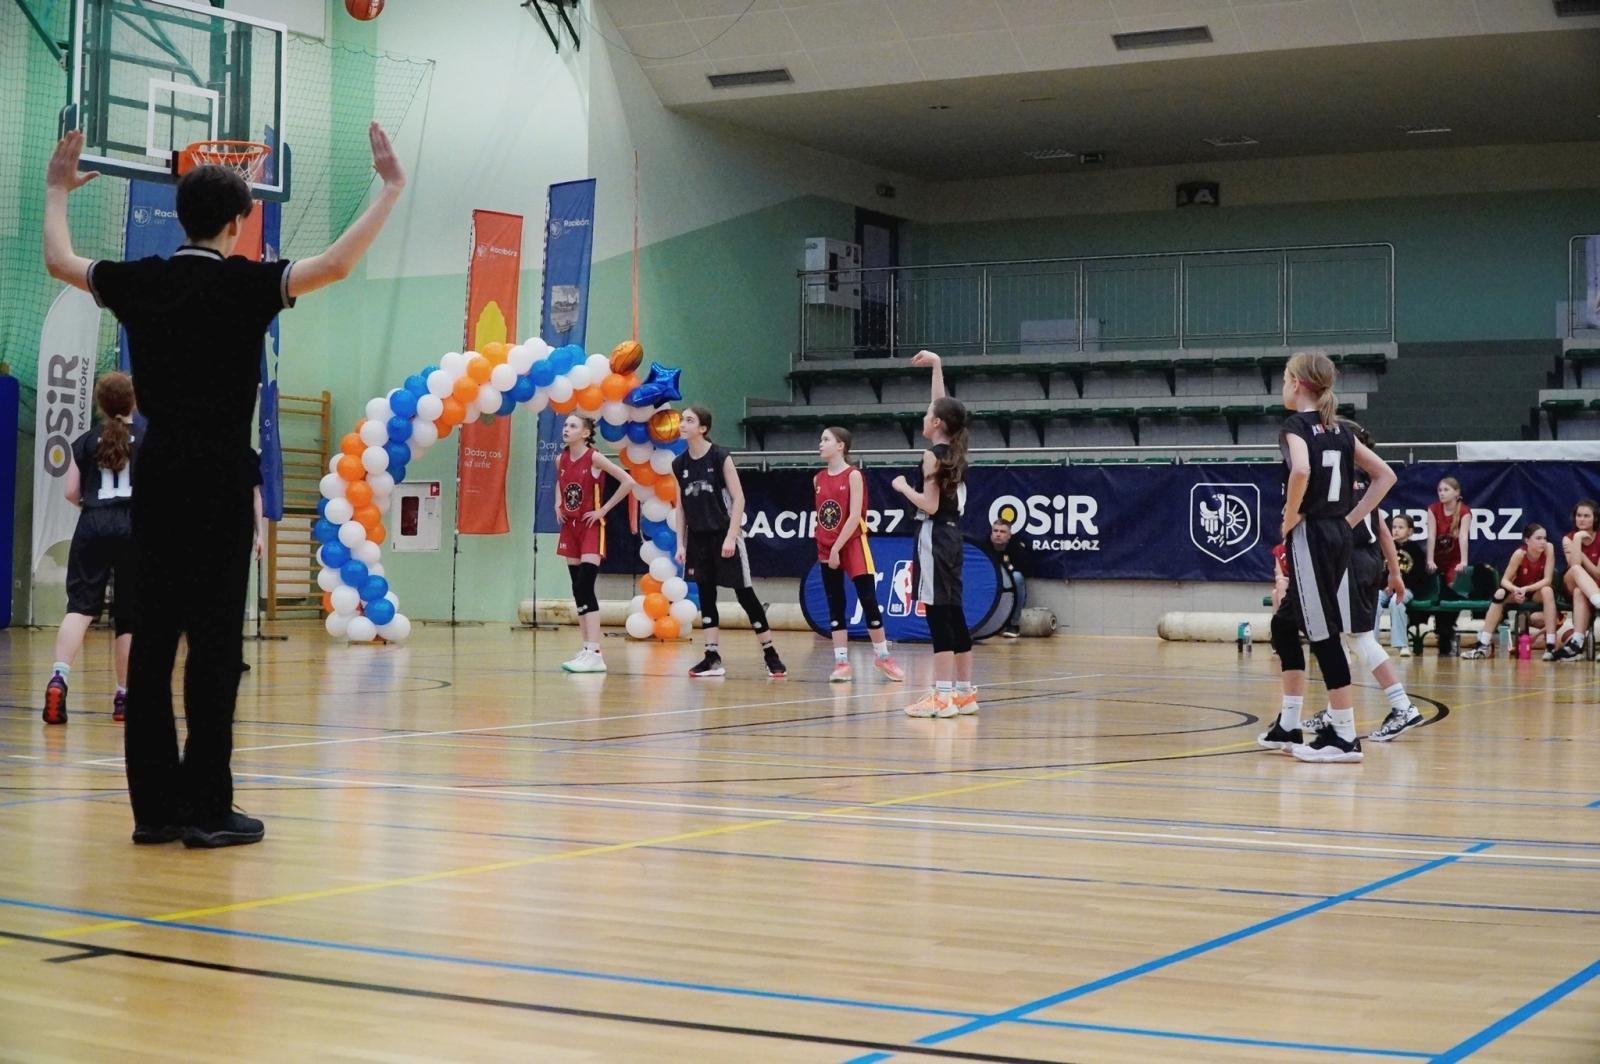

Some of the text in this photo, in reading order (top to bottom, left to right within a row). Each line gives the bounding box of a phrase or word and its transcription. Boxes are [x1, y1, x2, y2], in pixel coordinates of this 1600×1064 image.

[44, 354, 79, 478] OSiR
[78, 358, 90, 430] RACIBÓRZ
[1321, 449, 1342, 502] 7
[988, 494, 1099, 535] OSiR
[1032, 537, 1100, 551] RACIBÓRZ
